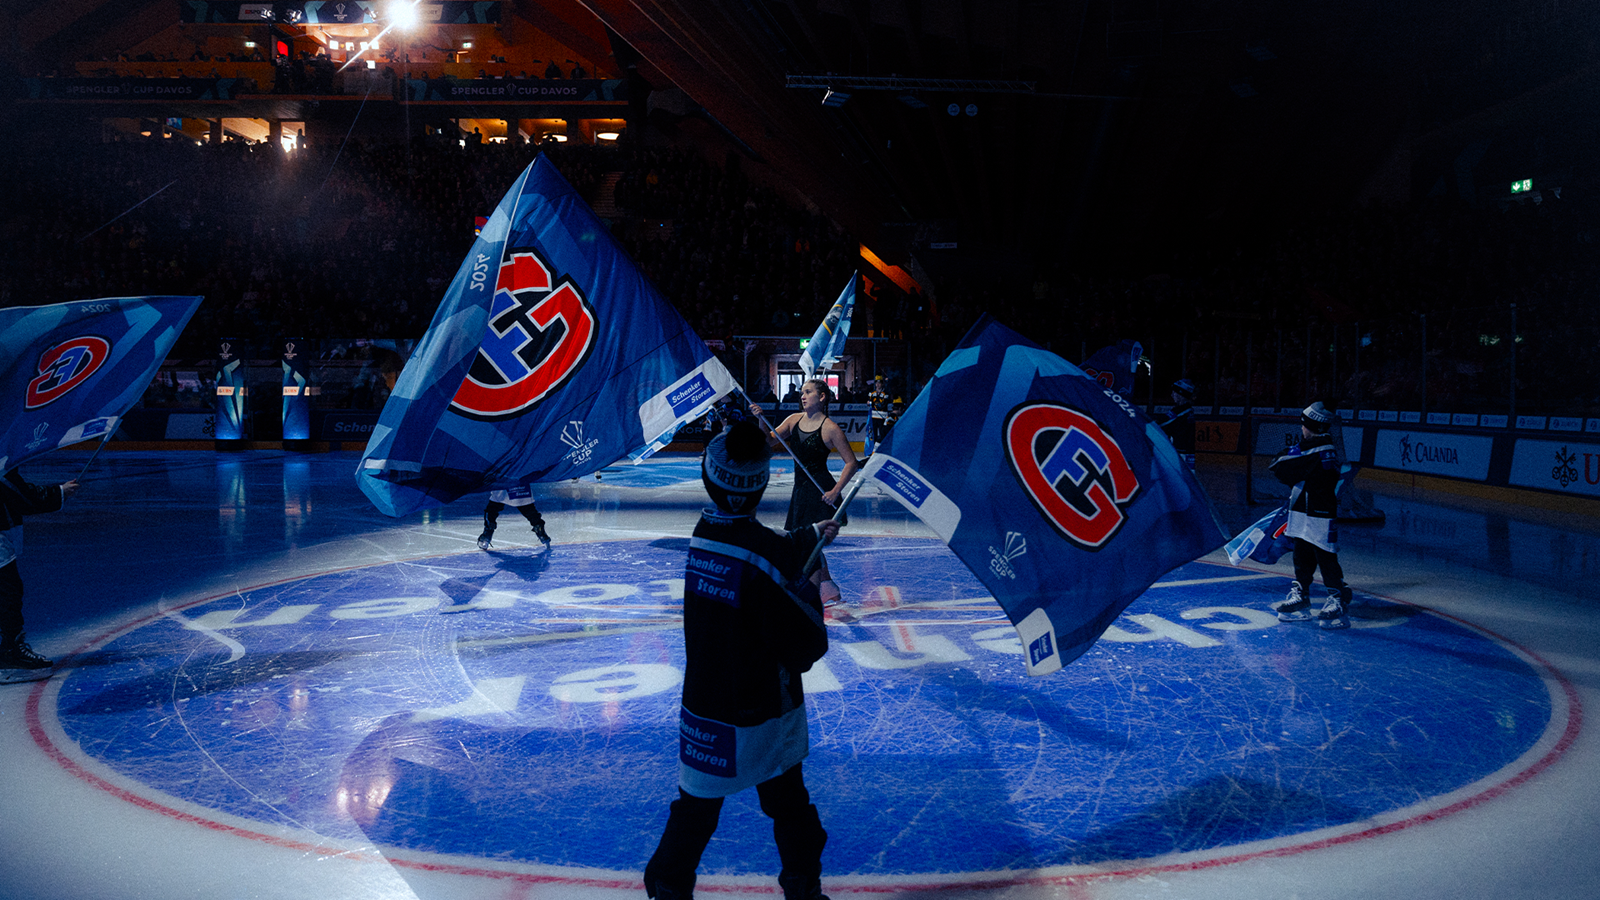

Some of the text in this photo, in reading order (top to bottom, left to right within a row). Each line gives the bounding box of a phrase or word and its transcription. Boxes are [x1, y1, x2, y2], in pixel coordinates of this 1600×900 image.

[66, 85, 193, 95] SPENGLER CUP DAVOS
[451, 86, 578, 96] SPENGLER CUP DAVOS
[671, 381, 702, 404] Schenker
[690, 387, 712, 404] Storen
[1103, 389, 1136, 418] 2024
[572, 448, 593, 465] CUP
[886, 464, 922, 491] Schenker
[895, 481, 921, 503] Storen
[686, 554, 732, 575] henker
[990, 558, 1007, 577] CUP
[697, 577, 736, 601] Storen
[680, 717, 718, 743] henker
[685, 743, 728, 768] Storen
